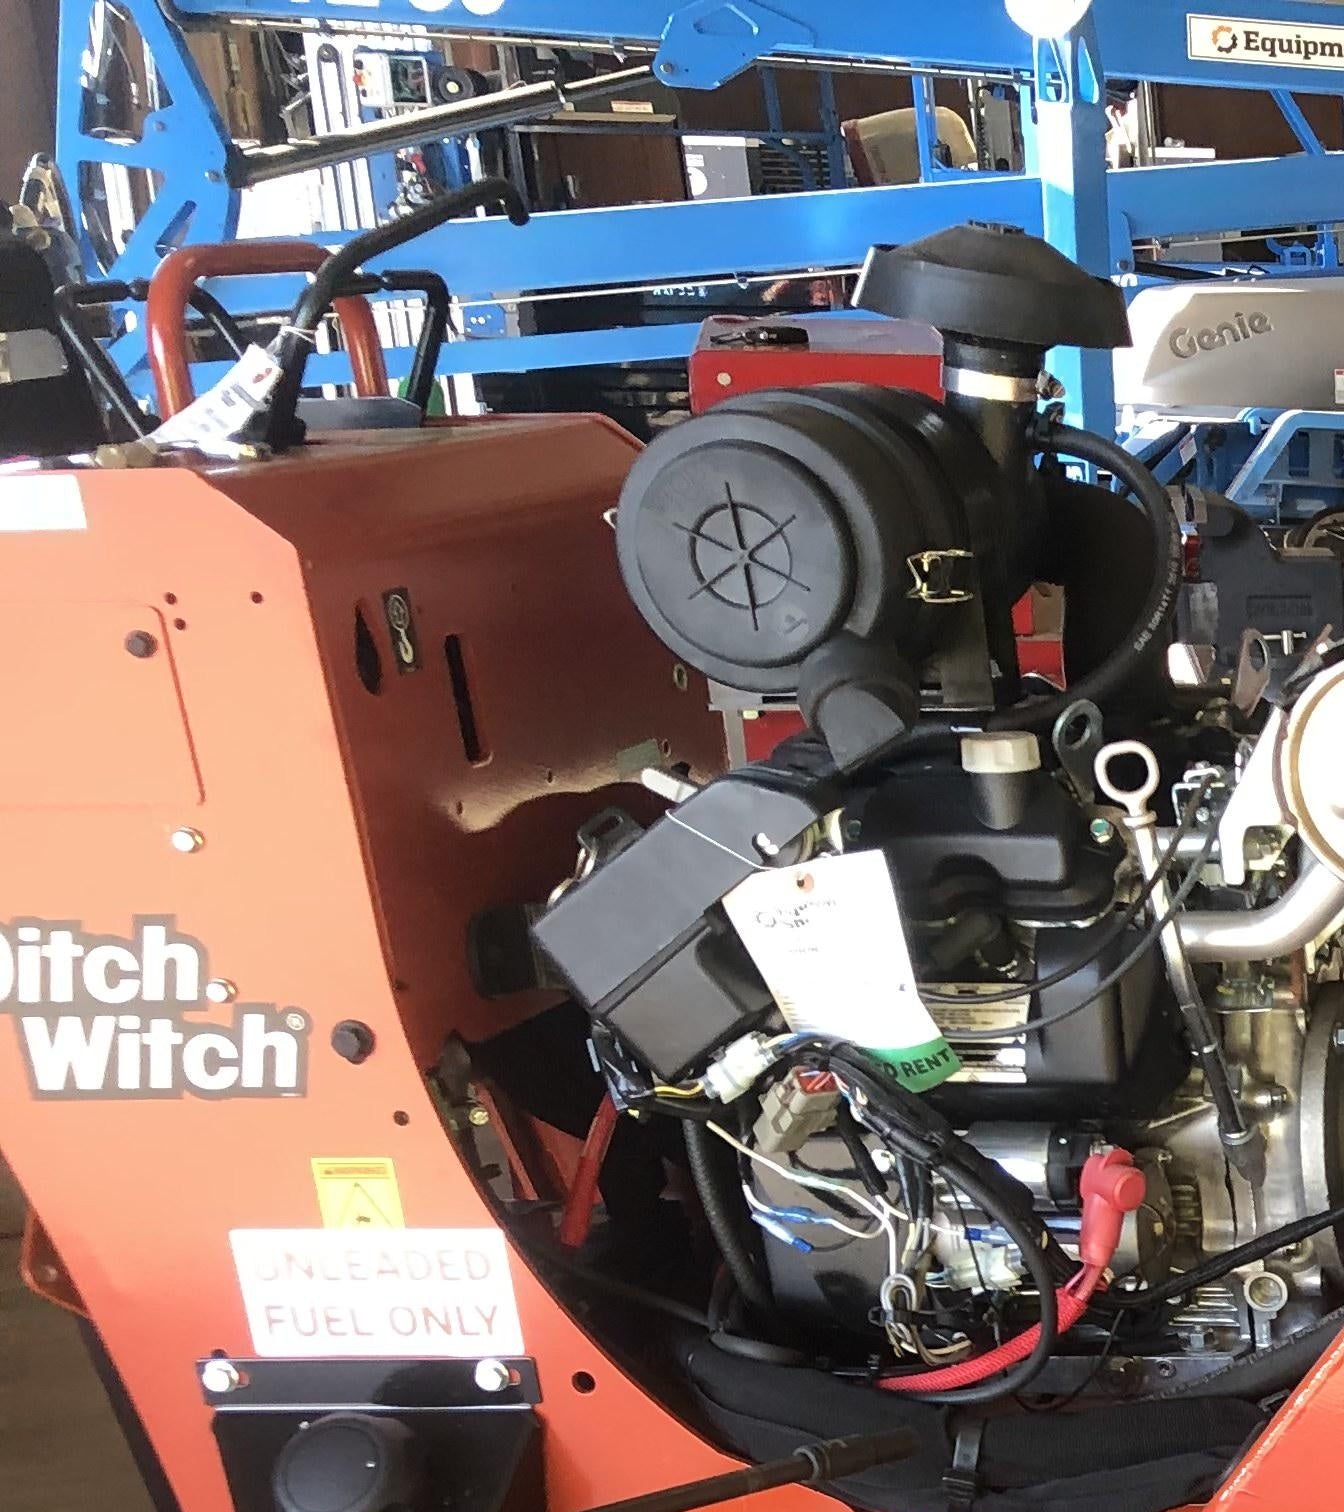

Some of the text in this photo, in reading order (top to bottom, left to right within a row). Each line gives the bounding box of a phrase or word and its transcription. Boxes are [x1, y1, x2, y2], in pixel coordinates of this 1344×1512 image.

[1169, 311, 1273, 359] Genie
[0, 925, 200, 1004] itch
[253, 1250, 492, 1281] UNLEADED
[264, 1304, 498, 1337] FUEL ONLY
